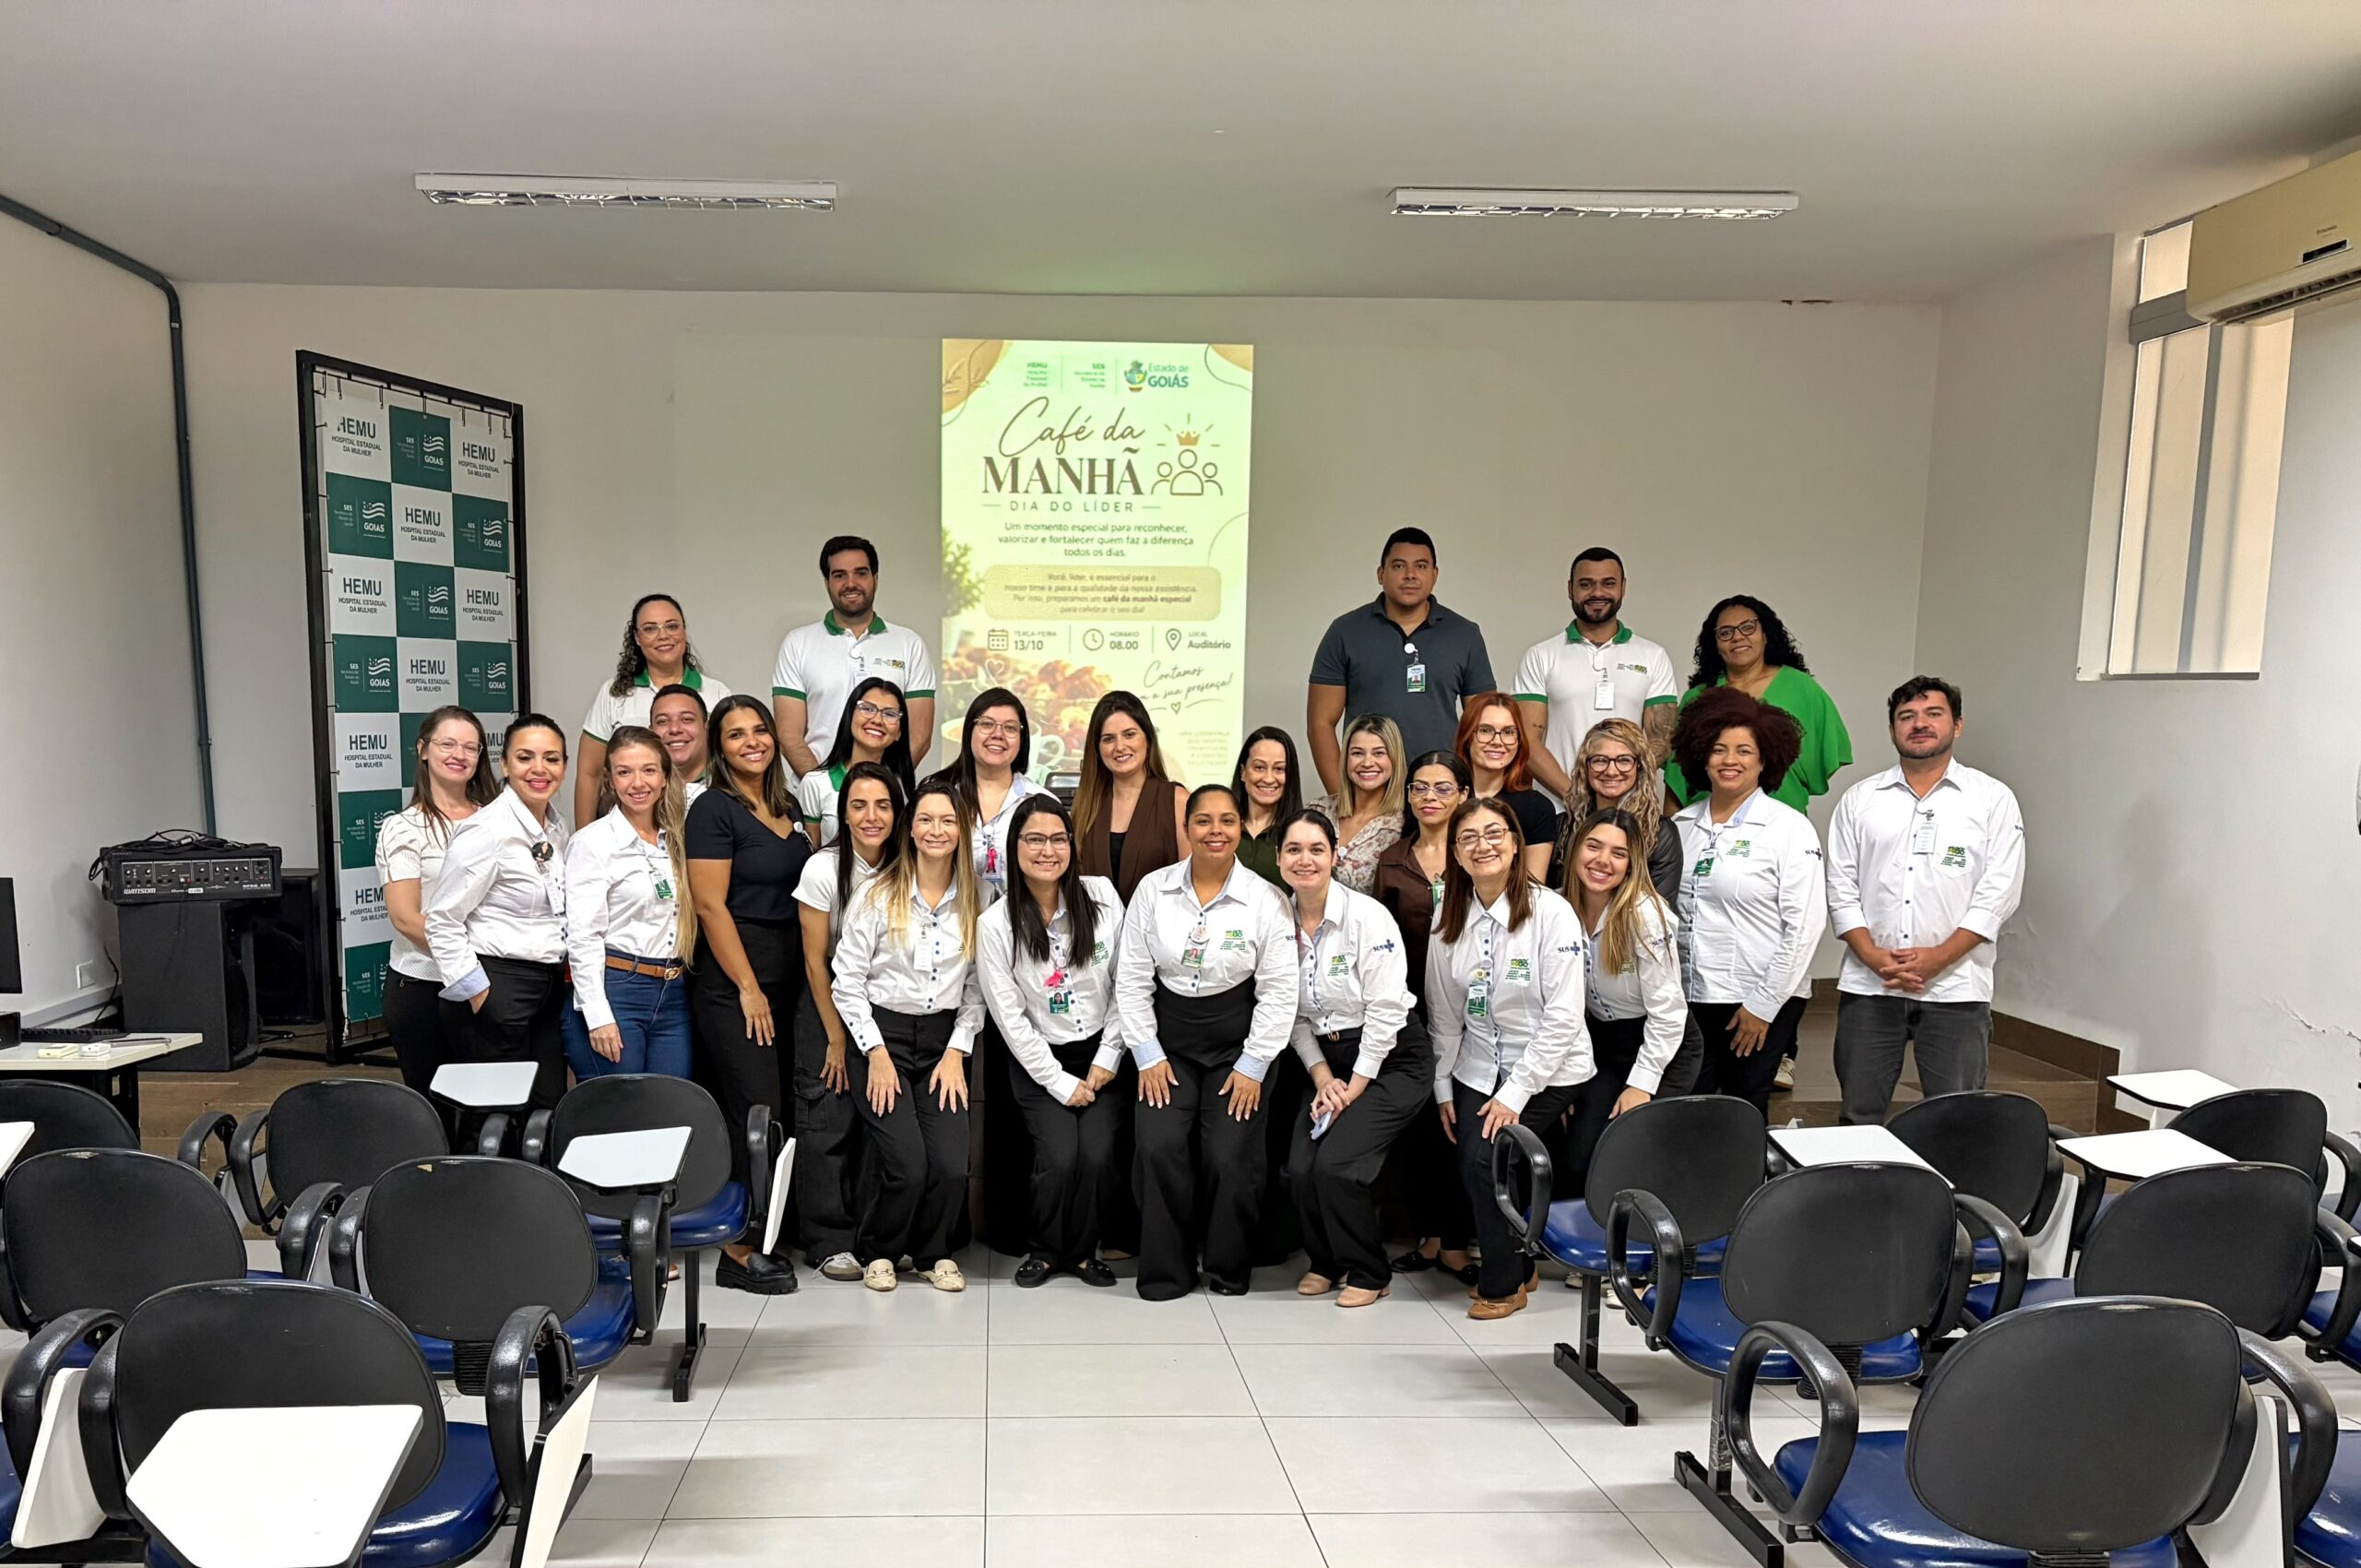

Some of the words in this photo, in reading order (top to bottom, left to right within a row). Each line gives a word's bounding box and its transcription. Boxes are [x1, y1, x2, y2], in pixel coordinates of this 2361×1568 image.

[1148, 363, 1176, 374] Estado
[1178, 364, 1190, 374] de
[1148, 374, 1189, 388] GOIÁS
[338, 416, 376, 439] HEMU
[999, 396, 1095, 457] Café
[1103, 406, 1145, 441] da
[332, 435, 355, 446] HOSPITAL
[357, 440, 382, 451] ESTADUAL
[351, 447, 372, 457] MULHER
[462, 442, 495, 462] HEMU
[982, 446, 1145, 495] MANHÃ
[1010, 501, 1038, 511] DIA
[1050, 501, 1073, 512] DO
[1084, 501, 1133, 512] LÍDER
[406, 506, 441, 527] HEMU
[400, 526, 422, 535] HOSPITAL
[423, 529, 445, 538] ESTADUAL
[1004, 522, 1021, 531] Um
[1024, 523, 1069, 531] momento
[1071, 523, 1109, 533] especial
[1111, 524, 1132, 533] para
[1134, 523, 1188, 533] reconhecer,
[419, 536, 436, 544] MULHER
[998, 535, 1038, 543] valorizar
[1049, 535, 1095, 544] fortalecer
[1097, 537, 1123, 545] quem
[1126, 536, 1140, 544] faz
[1150, 536, 1193, 546] diferença
[1063, 547, 1090, 556] todos
[1106, 548, 1126, 556] dias.
[1048, 573, 1067, 581] Você,
[343, 577, 382, 596] HEMU
[1080, 583, 1117, 592] qualidade
[1155, 584, 1197, 592] assistência.
[467, 588, 499, 606] HEMU
[1103, 594, 1119, 602] café
[1132, 594, 1158, 602] manhã
[1160, 595, 1192, 604] especial
[362, 599, 387, 607] ESTADUAL
[483, 608, 504, 616] ESTADUAL
[1060, 605, 1077, 613] para
[1078, 605, 1108, 613] celebrar
[1014, 639, 1044, 650] 13/10
[1109, 640, 1139, 650] 08.00
[1188, 639, 1231, 649] Auditório
[410, 659, 445, 674] HEMU
[1144, 659, 1204, 688] Contamos
[1163, 688, 1183, 699] sua
[1184, 671, 1234, 700] presença!
[350, 734, 387, 750] HEMU
[355, 887, 384, 905] HEM
[350, 908, 373, 916] HOSPITAL
